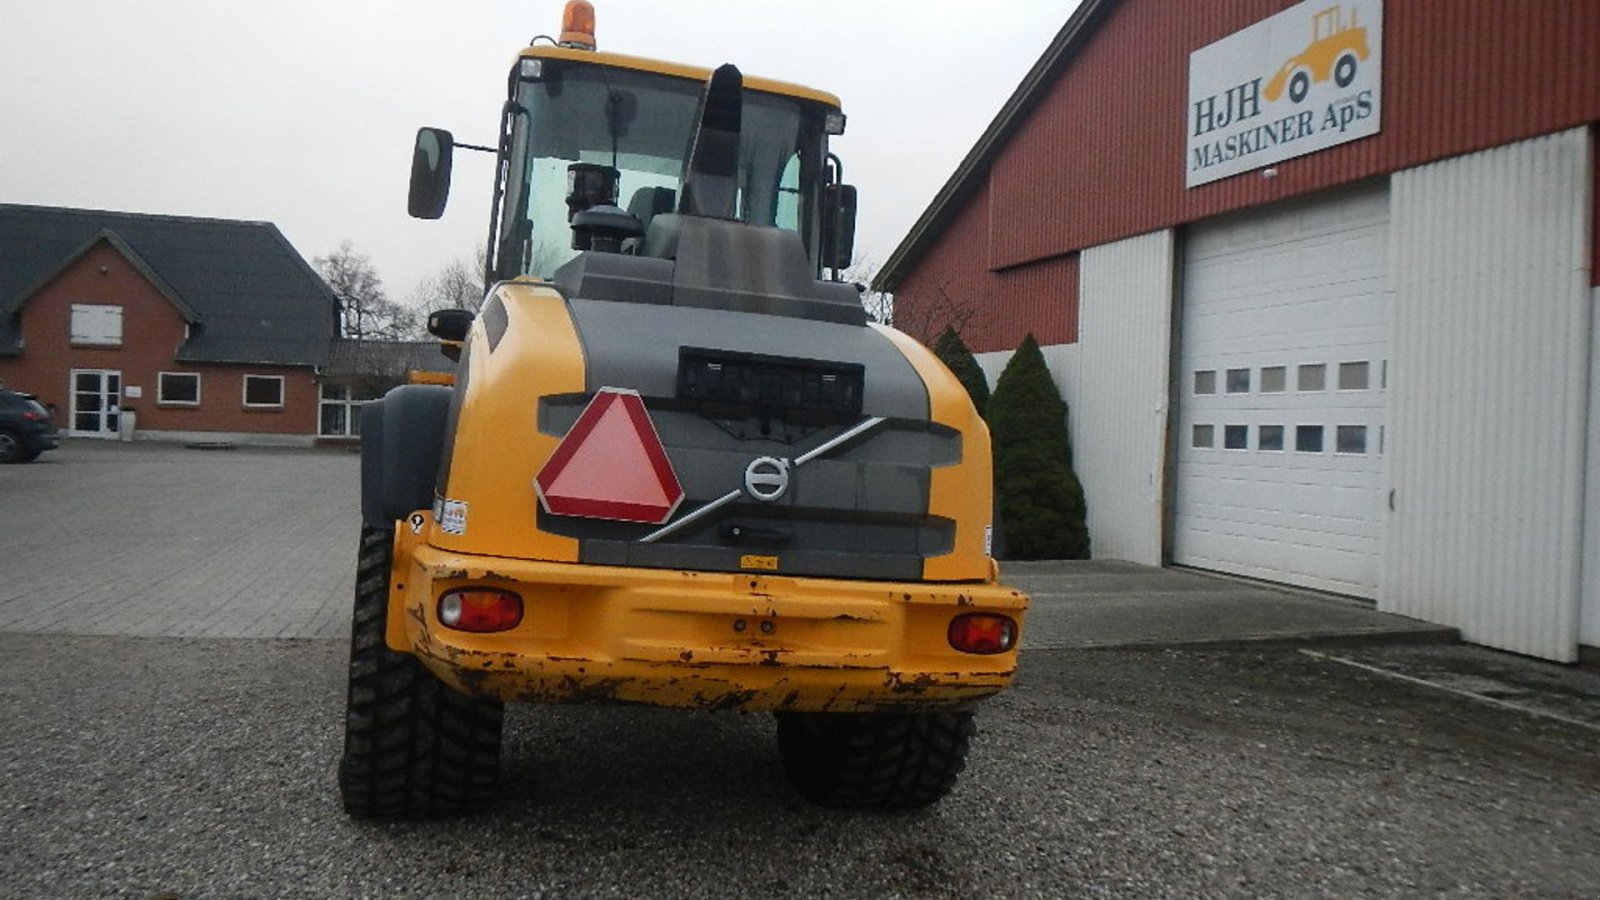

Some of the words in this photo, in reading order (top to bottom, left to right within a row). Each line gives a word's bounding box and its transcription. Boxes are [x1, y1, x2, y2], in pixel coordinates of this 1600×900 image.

[1192, 110, 1314, 171] MASKINER
[1320, 90, 1372, 132] ApS
[1194, 77, 1262, 137] HJH
